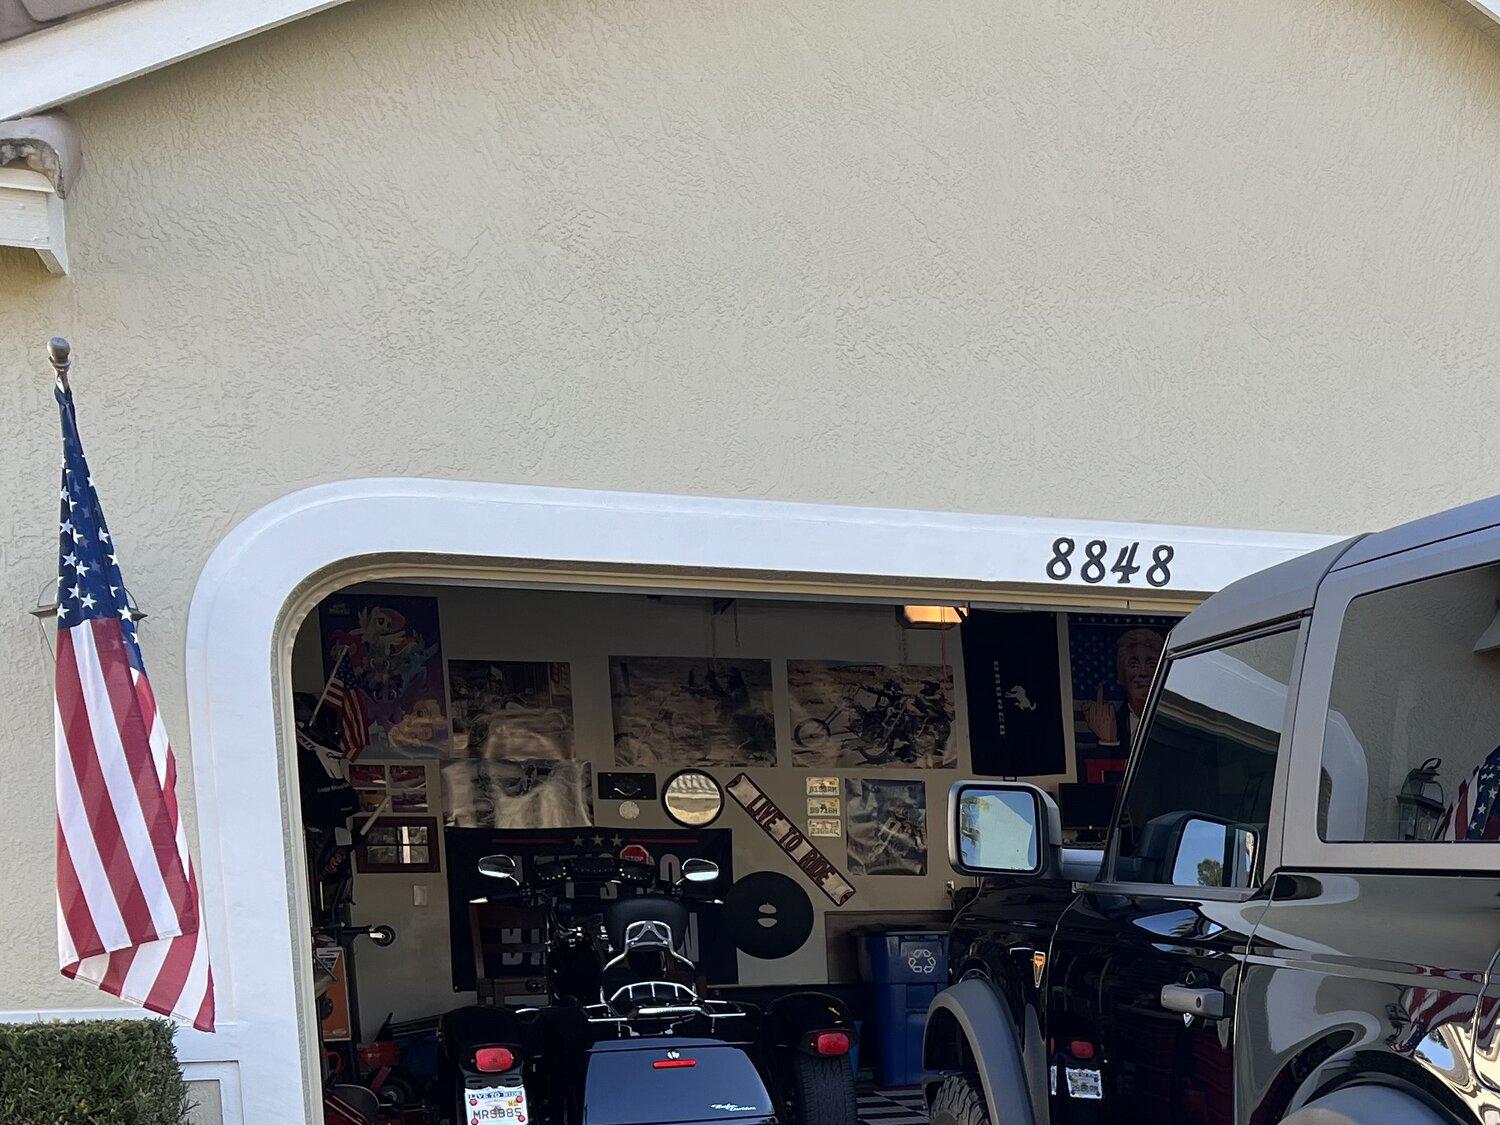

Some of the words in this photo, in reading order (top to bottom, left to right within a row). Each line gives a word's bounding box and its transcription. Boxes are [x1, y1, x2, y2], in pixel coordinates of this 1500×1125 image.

[1045, 537, 1175, 588] 8848
[992, 660, 1006, 736] BRONCO
[747, 794, 783, 831] LIVE
[779, 825, 804, 852] TO
[800, 848, 838, 887] RIDE
